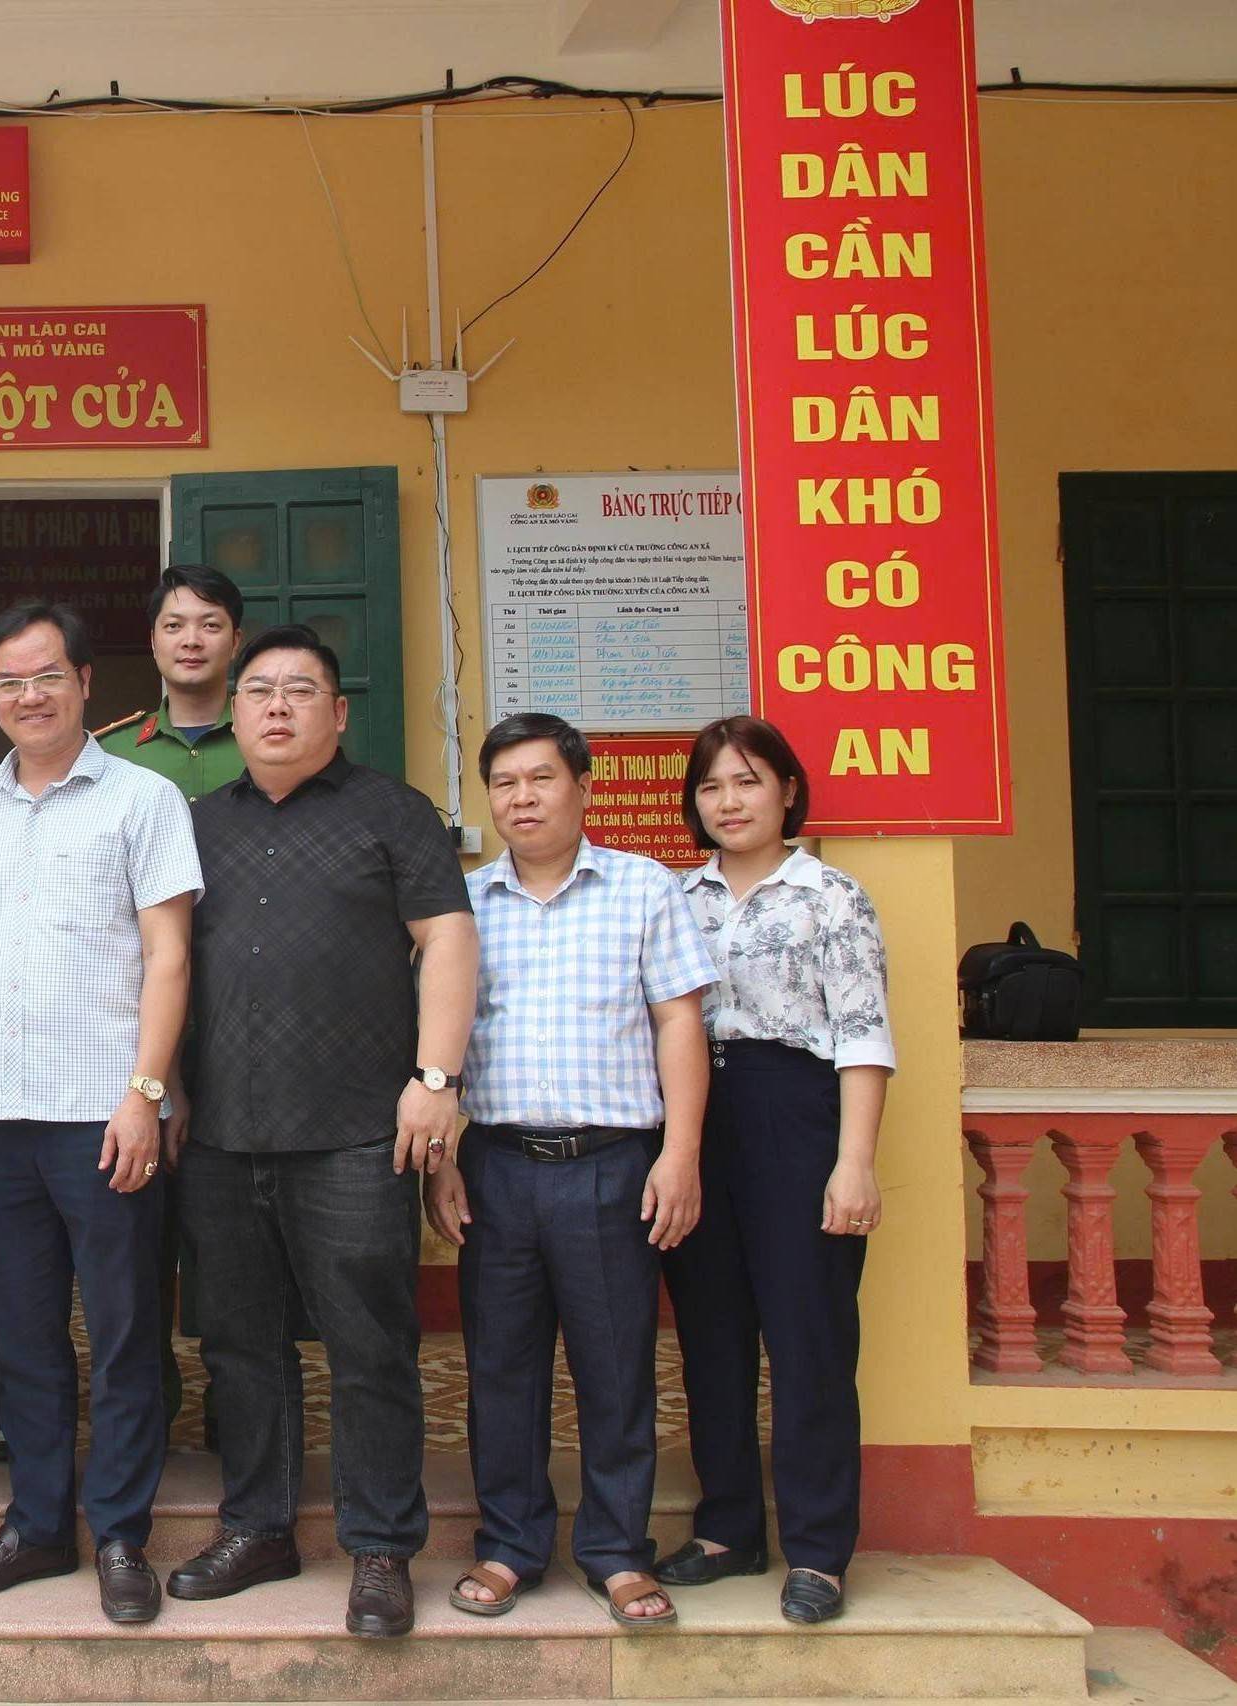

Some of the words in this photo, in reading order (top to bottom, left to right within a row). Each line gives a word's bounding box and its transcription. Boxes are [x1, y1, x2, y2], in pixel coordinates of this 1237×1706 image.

[783, 62, 916, 118] LÚC
[780, 143, 928, 198] DÂN
[10, 229, 22, 238] CAI
[785, 216, 932, 279] CẦN
[13, 339, 45, 357] MỎ
[51, 341, 106, 357] VÀNG
[29, 321, 66, 337] LÀO
[73, 323, 106, 336] CAI
[796, 303, 928, 360] LÚC
[71, 366, 184, 428] CỬA
[792, 385, 940, 442] DÂN
[602, 487, 646, 517] BẢNG
[650, 490, 694, 522] TRỰC
[697, 484, 732, 516] TIẾP
[798, 467, 941, 525] KHÓ
[825, 550, 920, 608] CÓ
[777, 634, 976, 692] CÔNG
[592, 752, 619, 786] ĐIỆN
[622, 755, 656, 786] THOẠI
[659, 748, 690, 780] ĐƯỜN
[830, 728, 930, 775] AN
[586, 811, 602, 826] CỦA
[604, 811, 620, 826] CÁN
[638, 810, 662, 826] CHIẾN
[592, 791, 614, 808] NHẬN
[616, 789, 638, 806] PHẢN
[640, 789, 658, 806] ÁNH
[604, 832, 620, 846] BỘ
[622, 832, 650, 844] CÔNG
[654, 834, 671, 844] AN:
[654, 848, 674, 858] LÀO
[678, 850, 697, 858] CAI:
